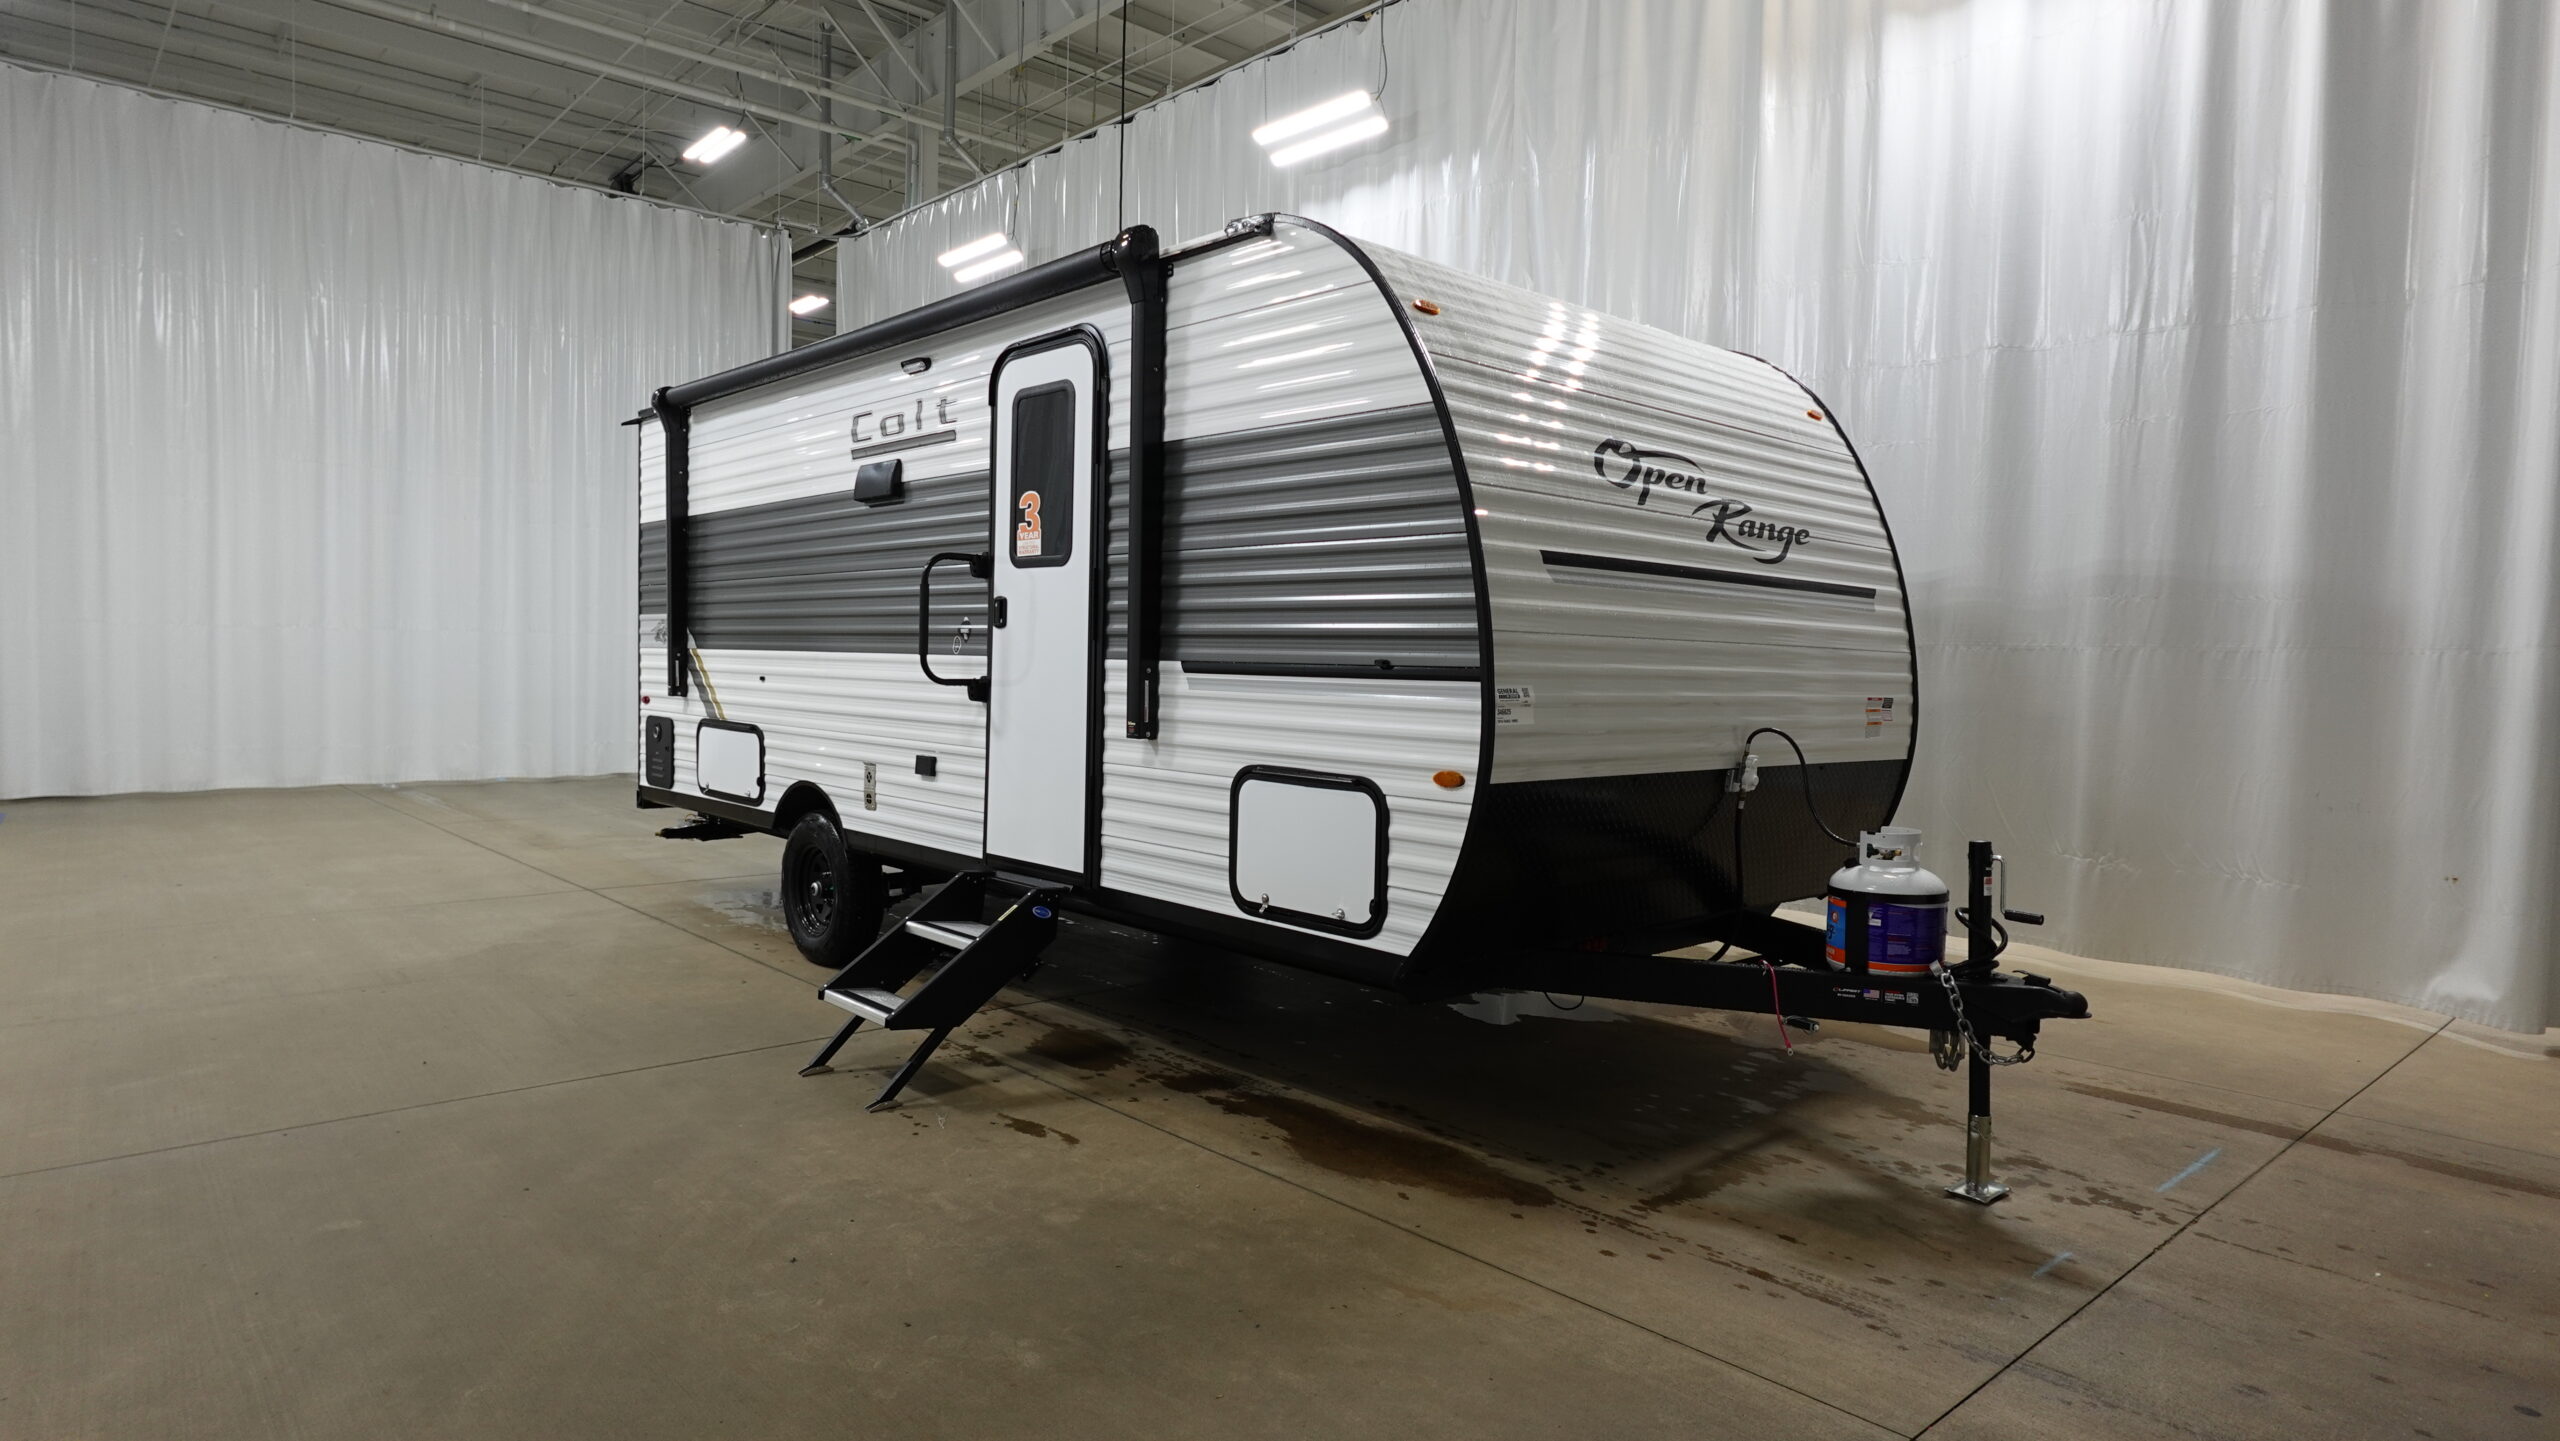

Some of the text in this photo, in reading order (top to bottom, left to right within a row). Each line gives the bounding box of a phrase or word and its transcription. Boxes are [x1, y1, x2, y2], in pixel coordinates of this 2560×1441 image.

[851, 396, 958, 443] Colt
[1594, 438, 1709, 506] Open
[1018, 491, 1041, 532] 3
[1692, 498, 1811, 565] Range
[1019, 531, 1039, 540] YEAR
